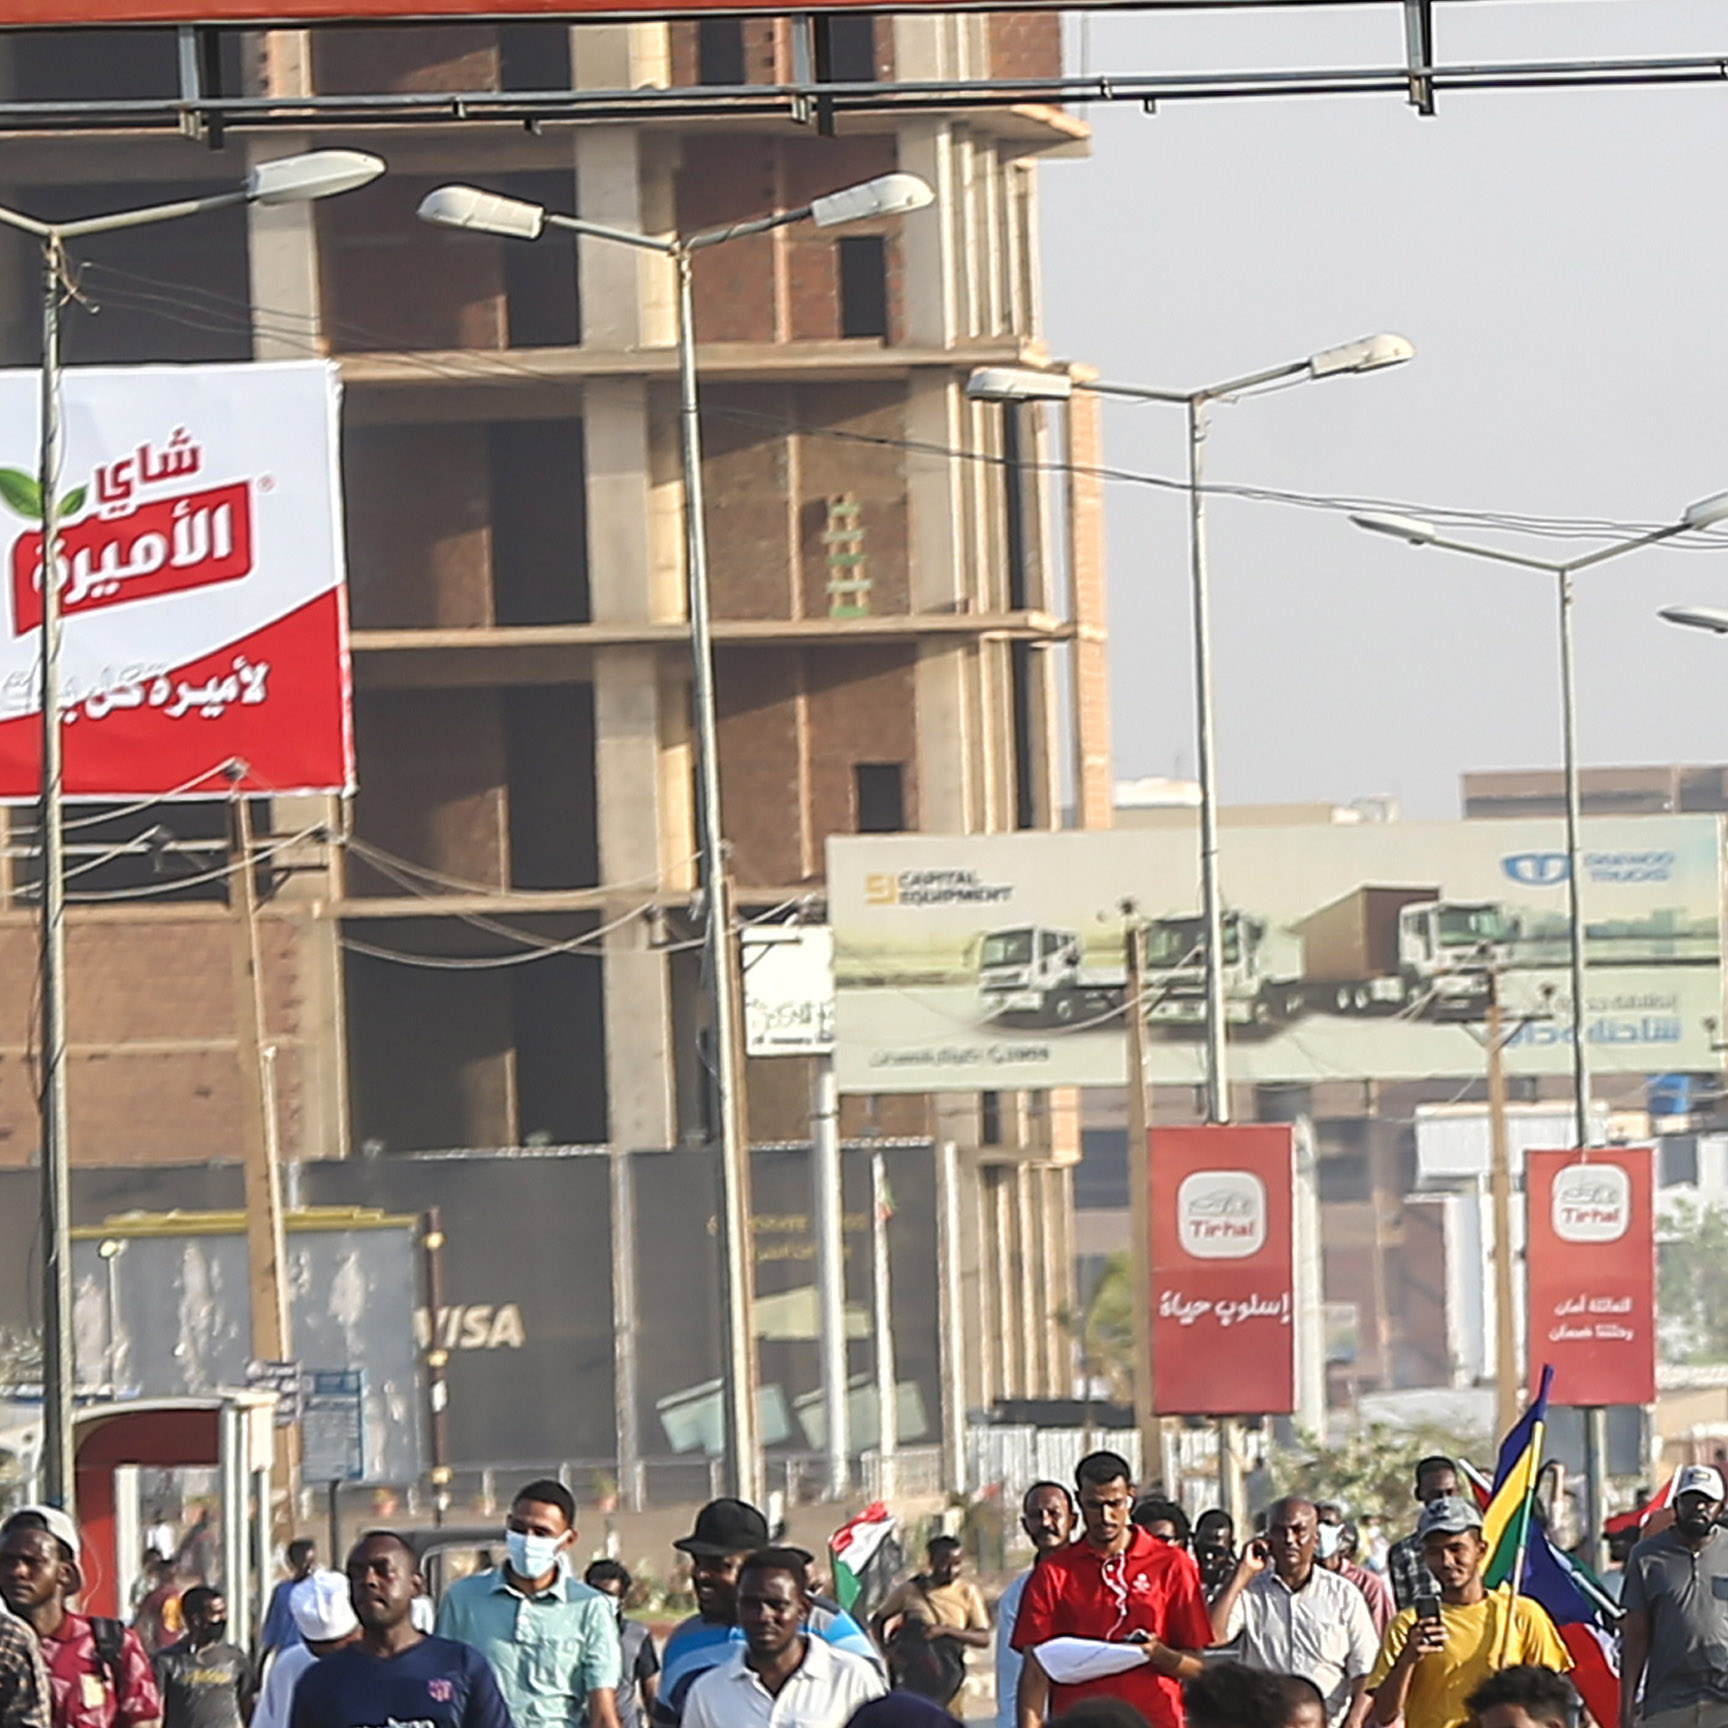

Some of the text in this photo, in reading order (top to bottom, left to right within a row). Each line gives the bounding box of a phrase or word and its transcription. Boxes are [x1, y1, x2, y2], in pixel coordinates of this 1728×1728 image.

[94, 425, 202, 514] شاي
[1188, 1219, 1255, 1239] Tirhal
[413, 1303, 526, 1349] VISA
